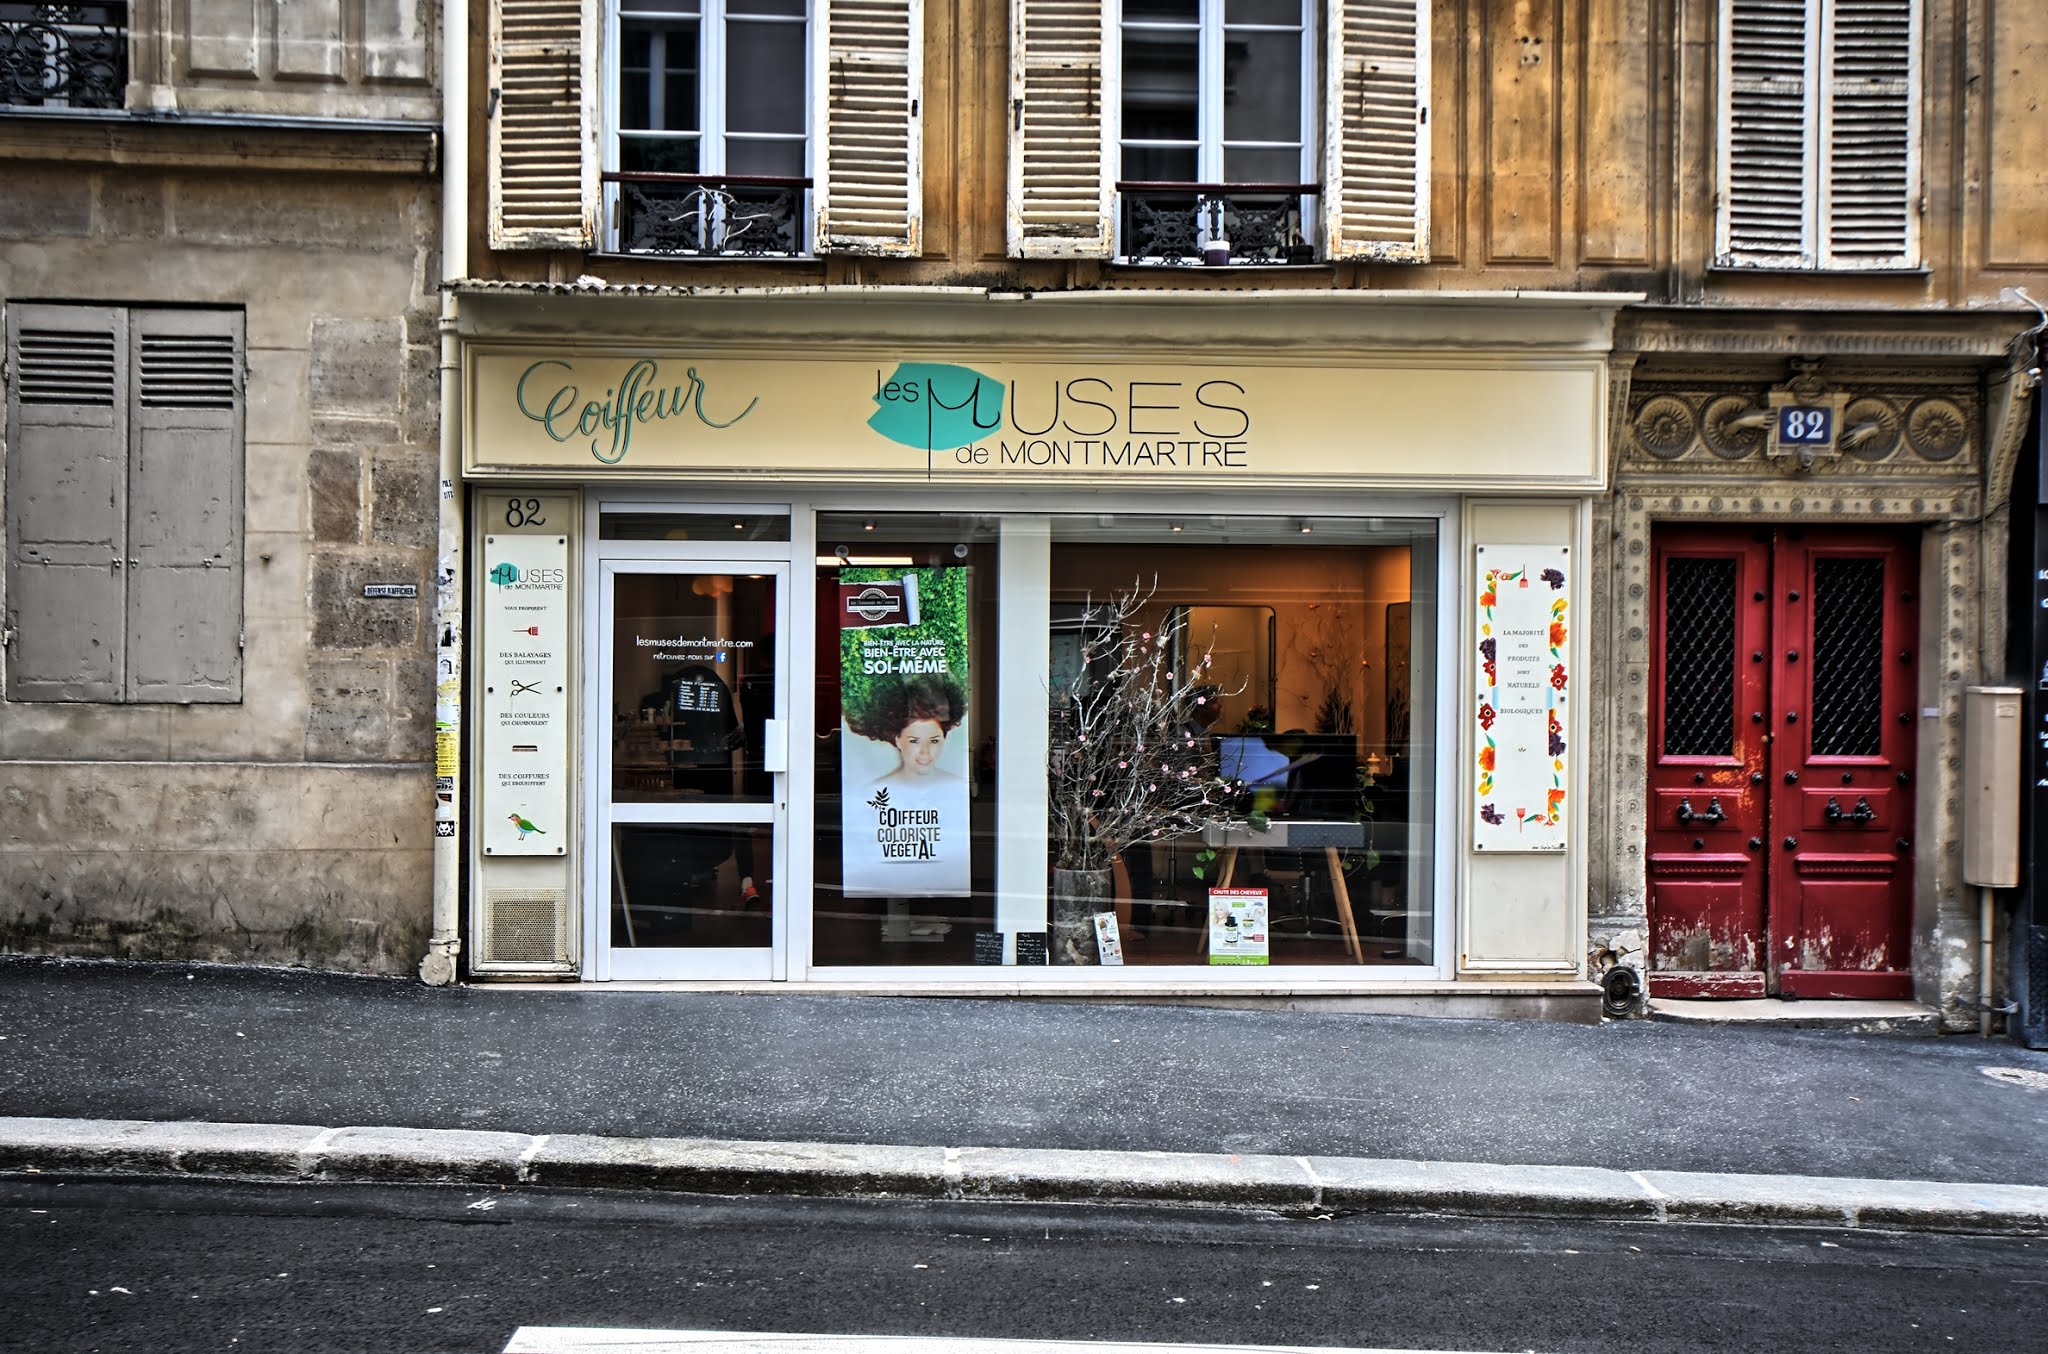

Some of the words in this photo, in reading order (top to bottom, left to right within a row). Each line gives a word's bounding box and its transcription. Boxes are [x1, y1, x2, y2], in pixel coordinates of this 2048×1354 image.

[876, 369, 920, 403] les
[517, 358, 760, 464] Coiffeur
[1786, 410, 1825, 439] 82
[955, 443, 990, 464] de
[1000, 440, 1249, 467] MONTMARTRE
[506, 498, 546, 528] 82
[515, 583, 564, 591] MONTMARTRE
[636, 635, 754, 648] lesmusesdemontmartre.com
[864, 645, 917, 658] BIEN-ÊTRE
[919, 647, 946, 657] AVEC
[653, 652, 703, 661] retrouvez-nous
[864, 656, 947, 675] SOI-MÊME
[879, 807, 939, 828] COIFFEUR
[877, 827, 941, 843] COLORISTE
[882, 839, 937, 860] VÉGÉTAL
